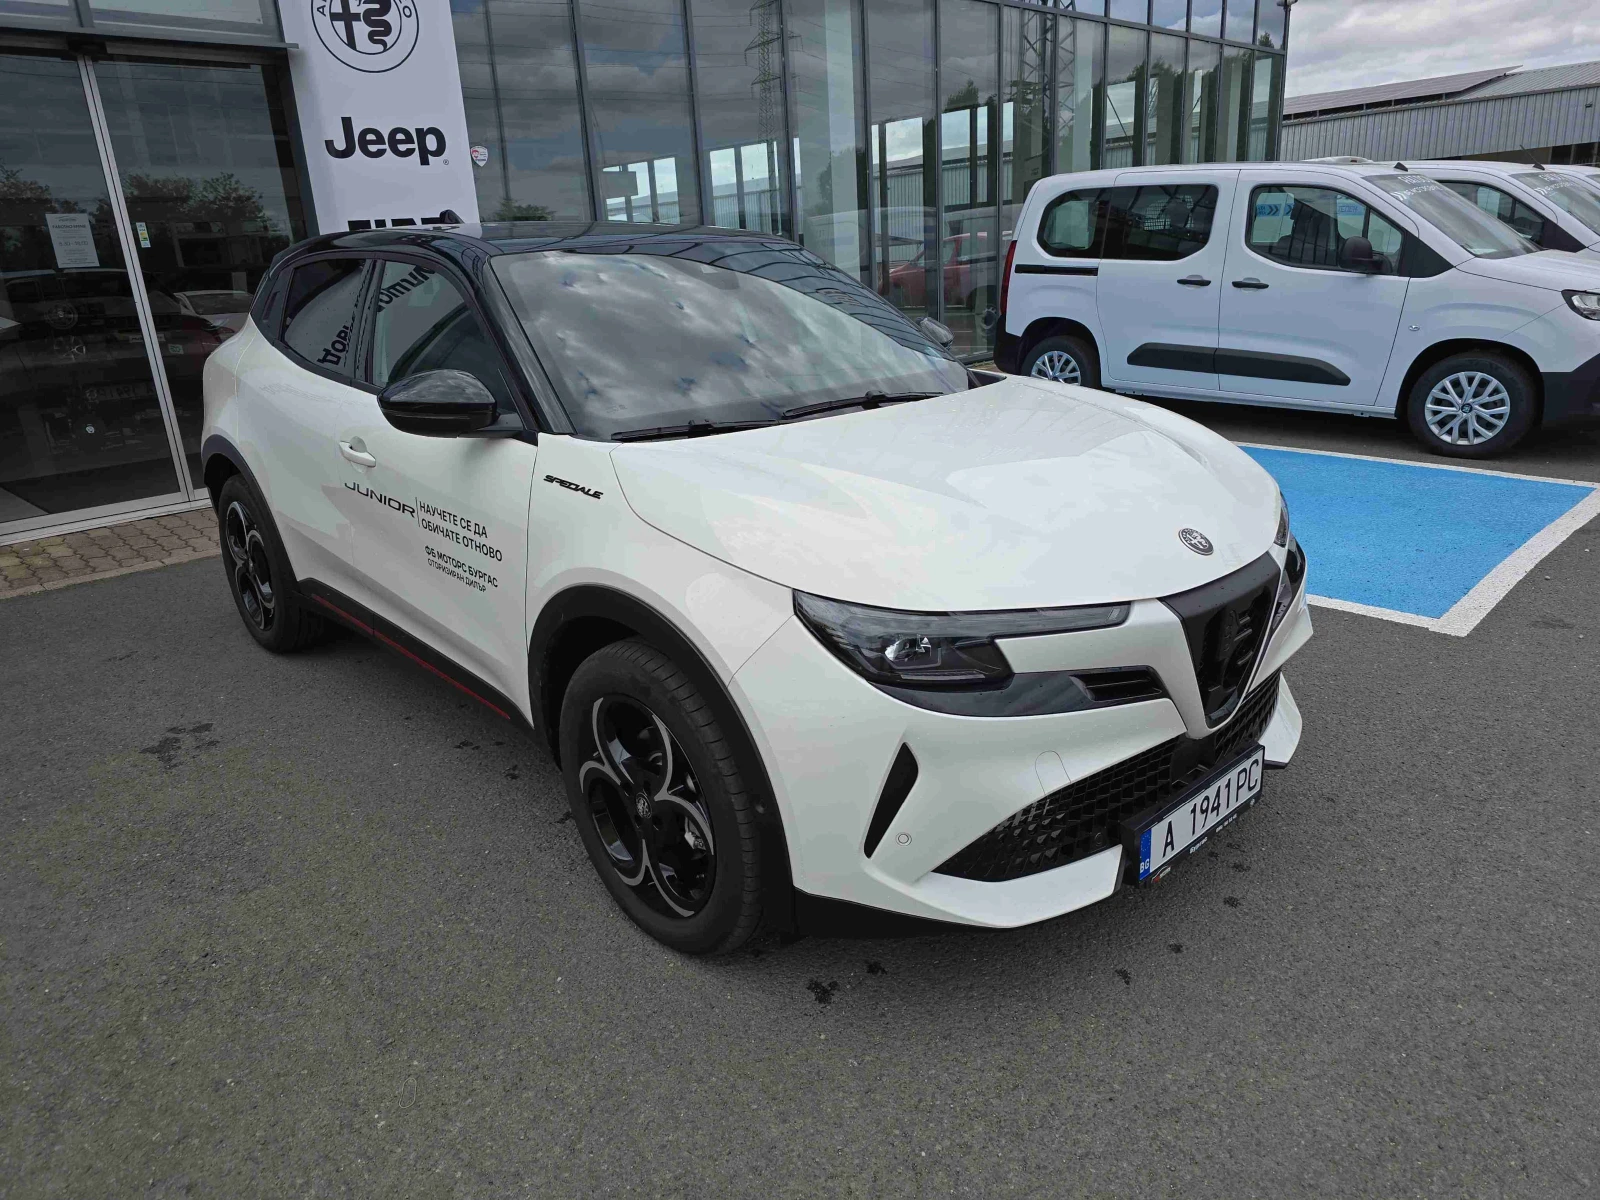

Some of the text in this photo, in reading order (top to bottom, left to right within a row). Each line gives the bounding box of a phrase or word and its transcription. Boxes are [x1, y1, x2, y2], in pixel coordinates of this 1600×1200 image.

[324, 116, 447, 166] Jeep
[344, 481, 416, 518] JUNIOR
[419, 500, 488, 539] НАУЧЕТЕ СЕ ДА
[421, 518, 503, 562] ОБИЧАТЕ ОТНОВО
[424, 545, 498, 588] ФБ МОТОРС БУРГАС
[1162, 820, 1175, 859] A
[1139, 858, 1150, 874] BG
